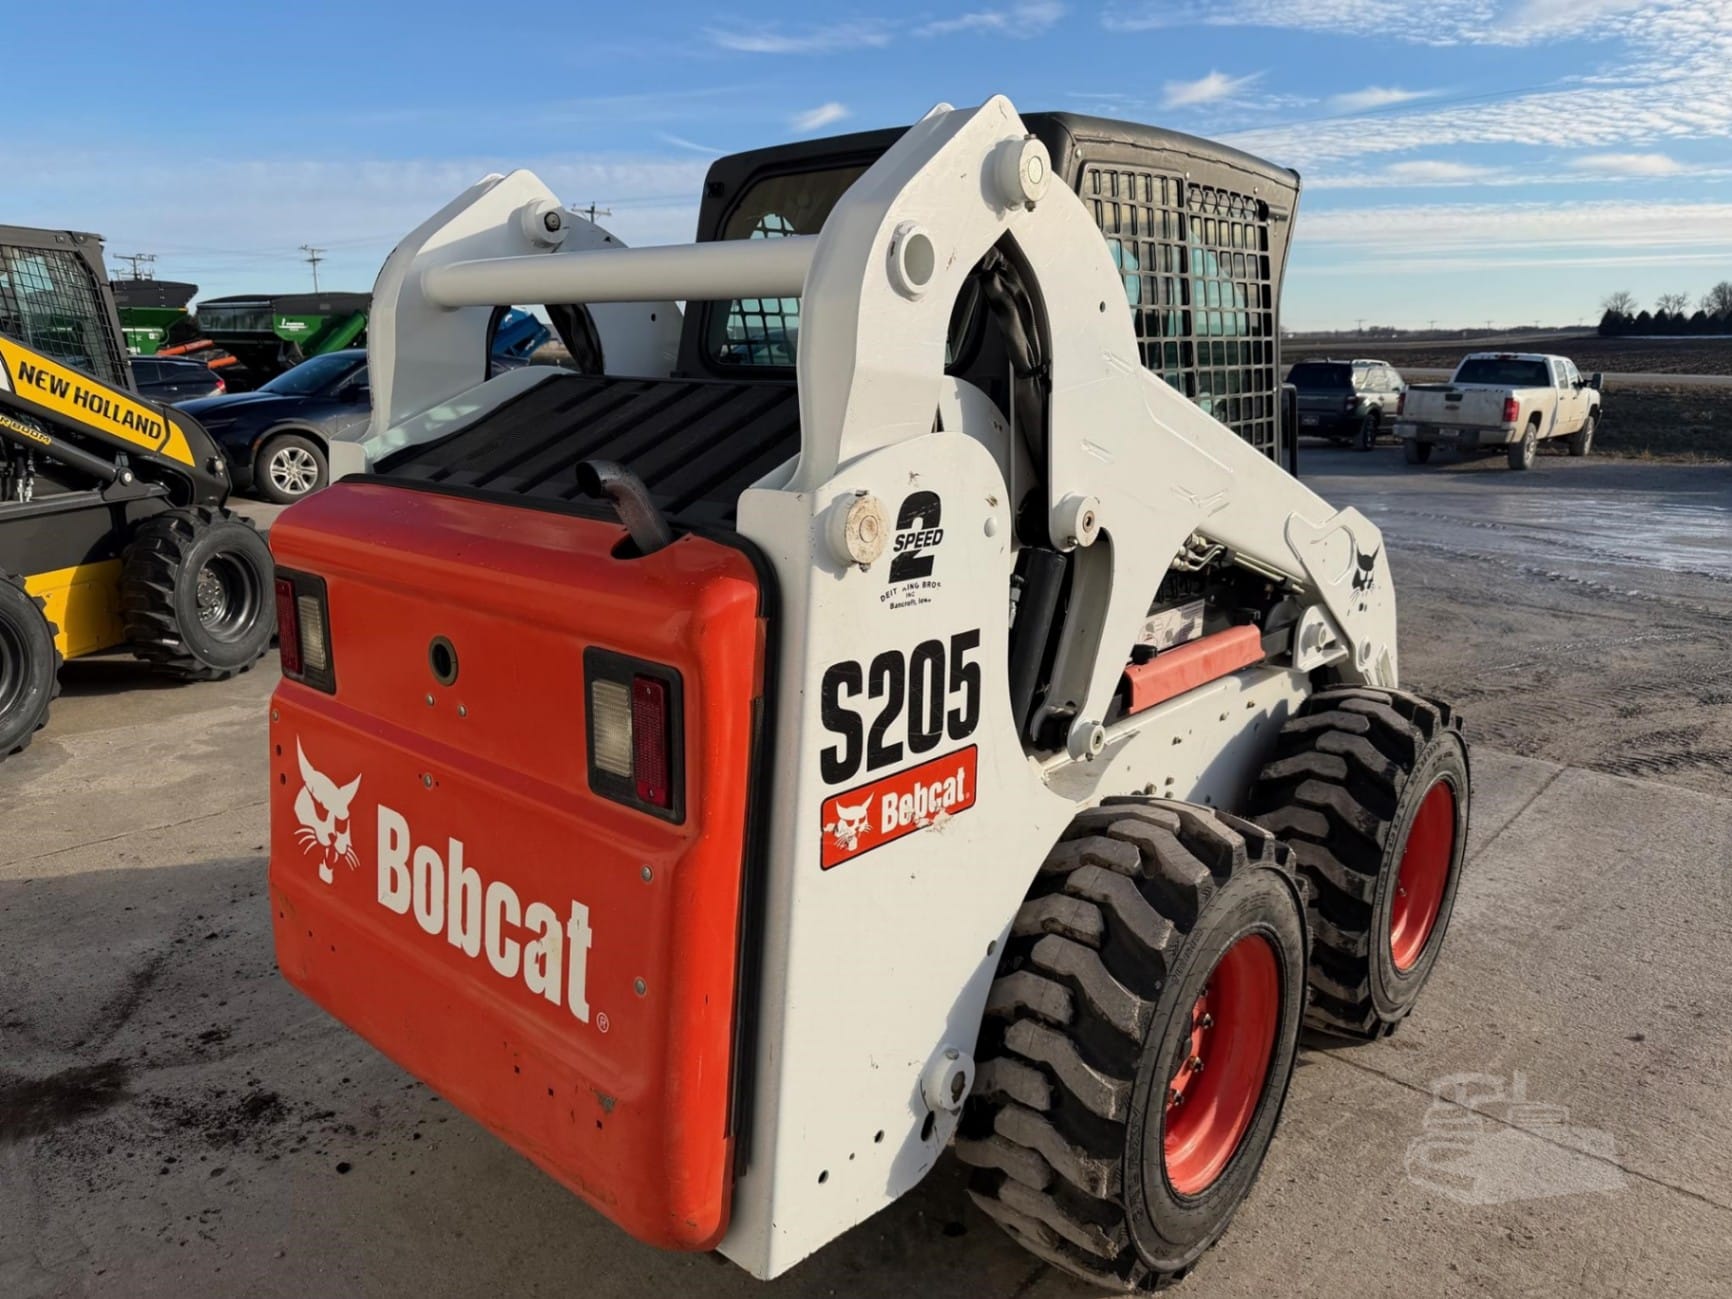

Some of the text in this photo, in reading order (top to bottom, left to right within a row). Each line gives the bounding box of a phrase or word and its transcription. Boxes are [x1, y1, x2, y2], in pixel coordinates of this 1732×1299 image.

[18, 361, 162, 440] NEW HOLLAND
[888, 490, 944, 584] 2 SPEED
[820, 628, 982, 785] S205
[881, 767, 965, 834] Bobcat
[378, 803, 592, 1024] Bobcat
